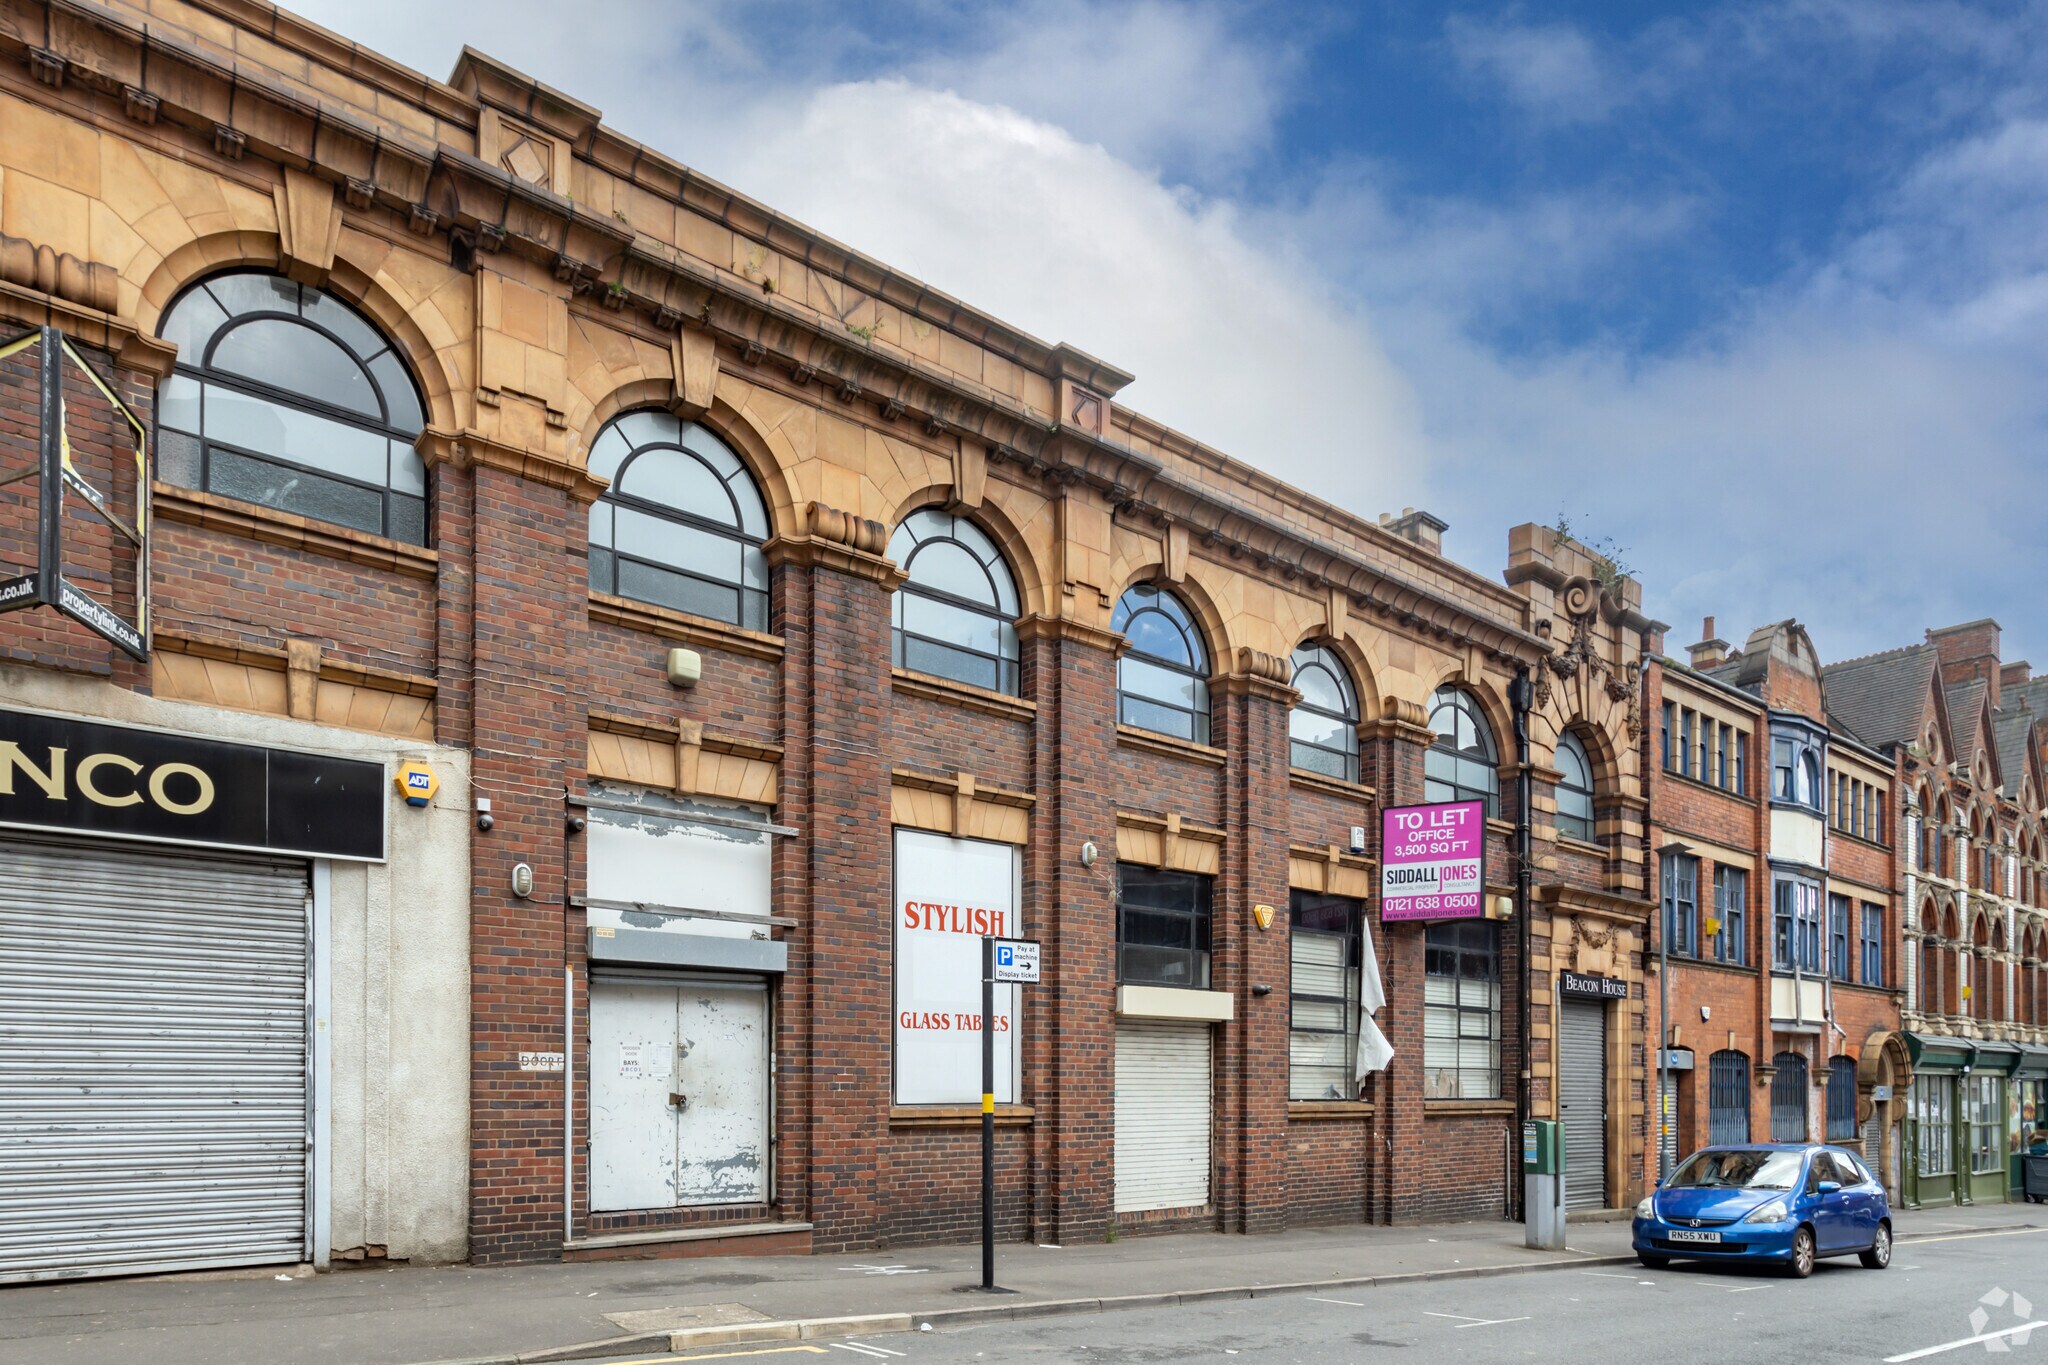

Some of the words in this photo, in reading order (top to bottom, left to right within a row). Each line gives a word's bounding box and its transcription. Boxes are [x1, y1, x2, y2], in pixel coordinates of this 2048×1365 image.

[62, 588, 140, 650] propertylink.co.uk
[409, 774, 429, 787] ADT
[1395, 812, 1423, 830] TO
[1430, 808, 1470, 827] LET
[1408, 829, 1455, 842] OFFICE
[1394, 844, 1427, 858] 3,500
[1430, 842, 1449, 854] SQ
[1452, 840, 1469, 852] FT
[1386, 867, 1438, 885] SIDDALL
[1437, 864, 1477, 893] JONES
[1386, 884, 1415, 892] COMMERCIAL
[1444, 881, 1475, 889] CONSULTANCY
[1385, 898, 1411, 911] 0121
[1415, 896, 1440, 910] 638
[1444, 894, 1477, 908] 0500
[905, 901, 1004, 937] STYLISH
[1386, 907, 1477, 919] www.siddalljones.com
[1017, 945, 1028, 953] Pay
[1566, 974, 1599, 992] BEACON
[1602, 978, 1627, 996] HOUSE
[900, 1011, 950, 1030] GLASS
[955, 1014, 1008, 1031] TABES
[521, 1056, 554, 1067] DOOR
[1671, 1231, 1695, 1240] RN55
[1697, 1232, 1716, 1241] XWU
